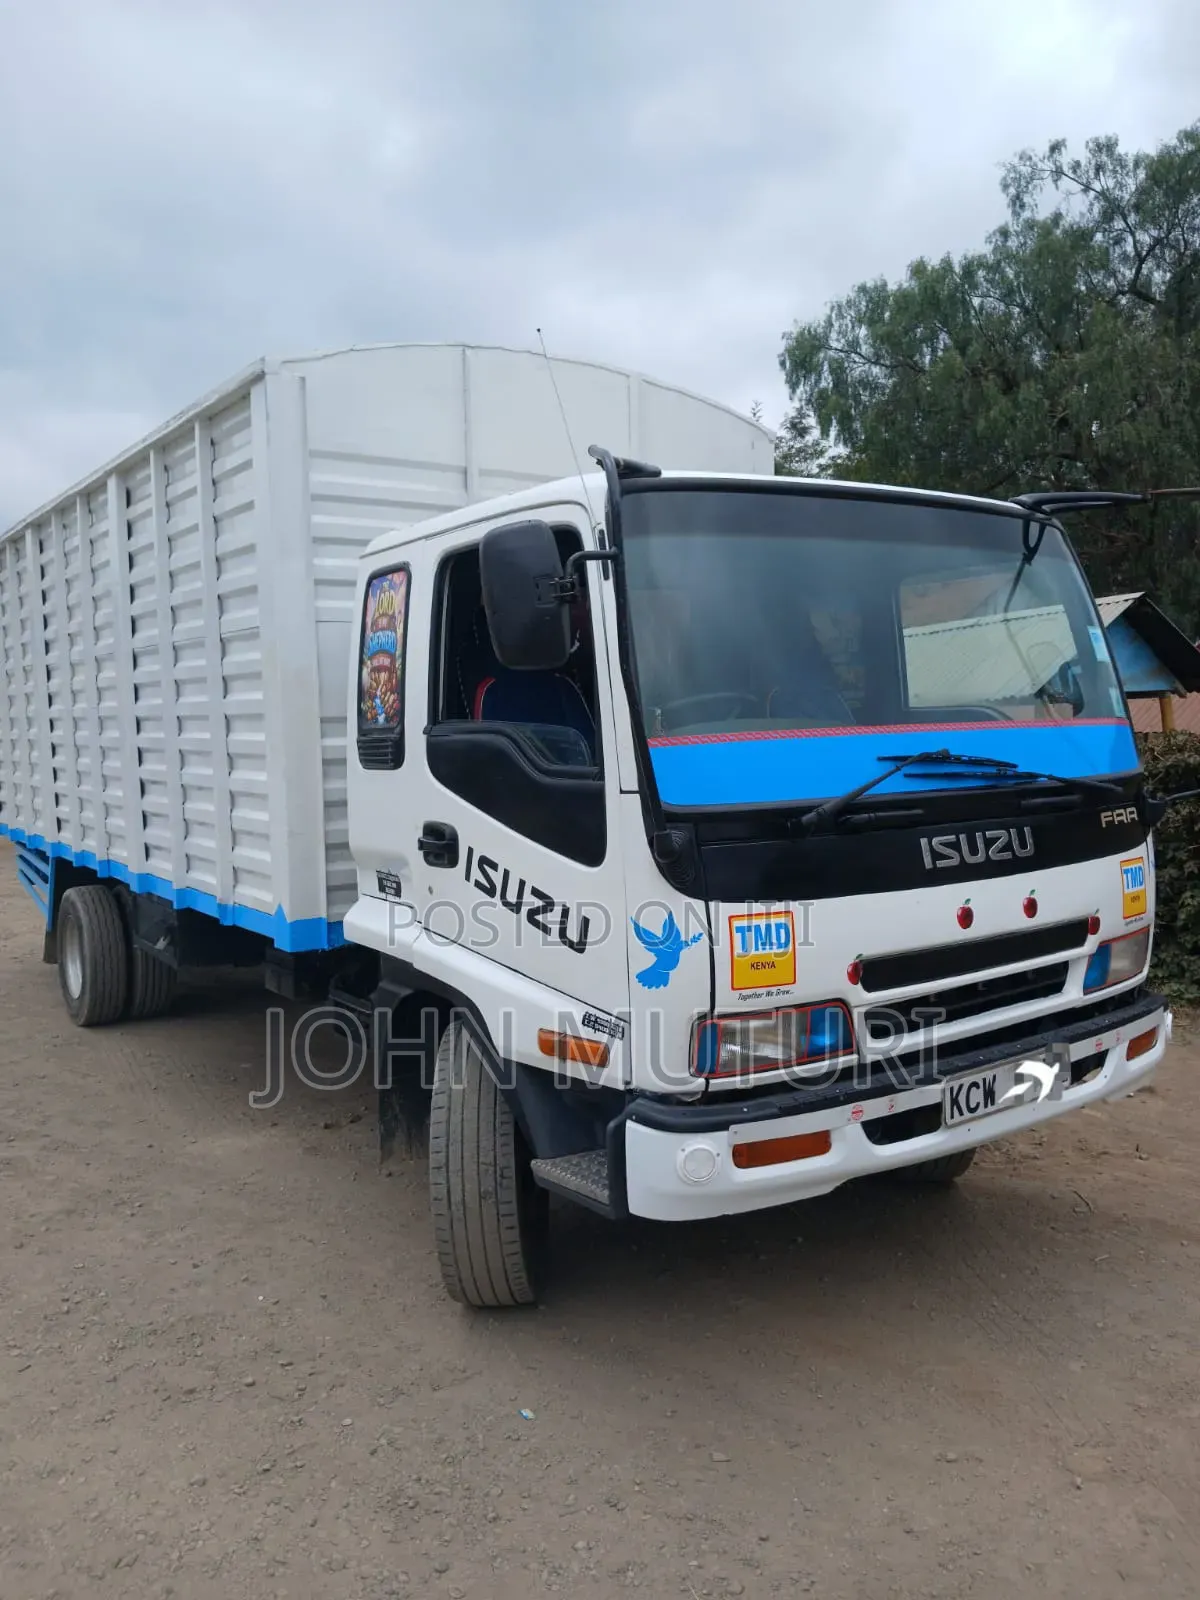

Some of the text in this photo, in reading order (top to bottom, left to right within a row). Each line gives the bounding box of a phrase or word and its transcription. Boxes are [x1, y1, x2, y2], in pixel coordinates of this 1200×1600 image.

[375, 590, 395, 614] LORD
[920, 826, 1035, 869] ISUZU
[1123, 865, 1144, 889] TMD
[464, 846, 591, 954] ISUZU
[735, 922, 790, 952] TMD
[750, 961, 776, 970] KENYA
[738, 992, 764, 1001] Together
[765, 990, 774, 998] We
[949, 1074, 997, 1120] KCW
